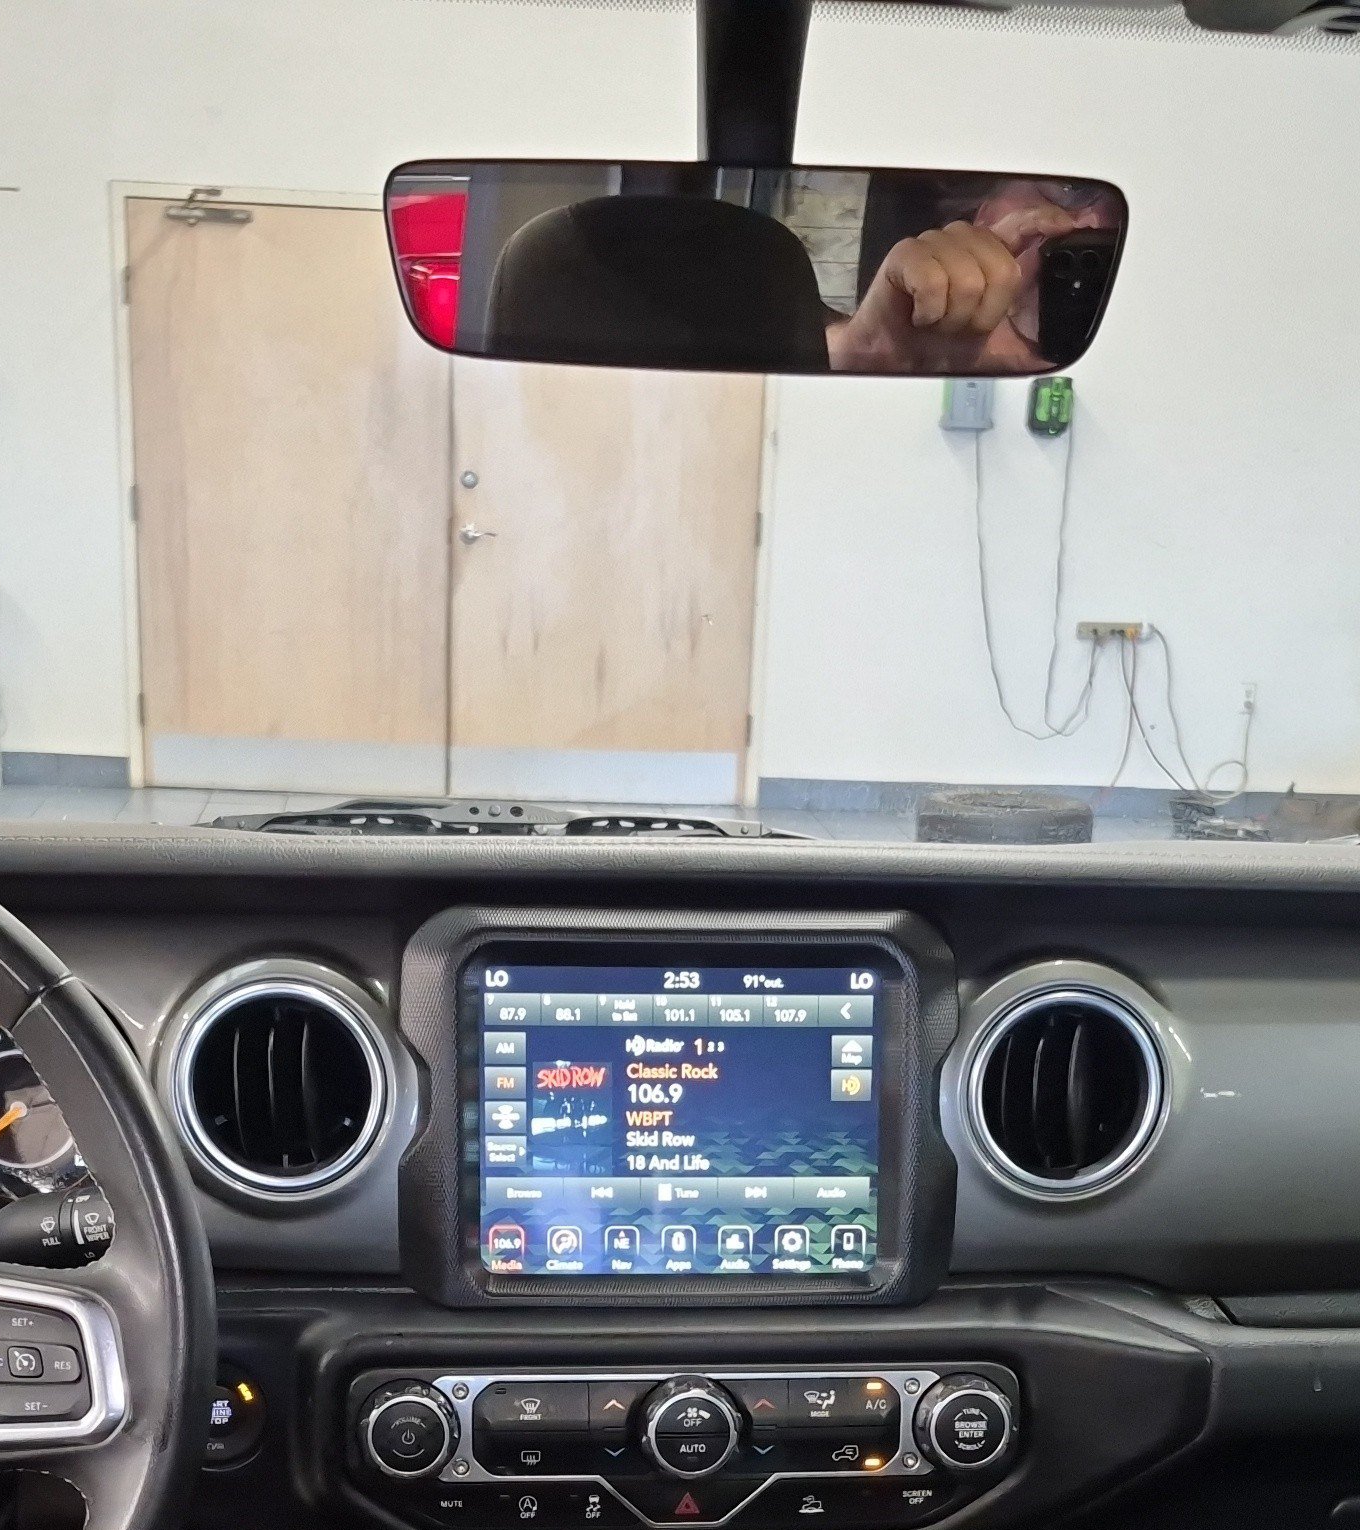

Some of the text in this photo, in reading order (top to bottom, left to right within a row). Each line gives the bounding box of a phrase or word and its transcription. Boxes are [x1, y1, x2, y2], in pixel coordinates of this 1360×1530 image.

[485, 970, 509, 987] LO
[663, 971, 700, 989] 2:53
[850, 972, 874, 990] LO
[664, 1009, 695, 1022] 101.1
[774, 1009, 807, 1022] 107.9
[537, 1066, 606, 1088] SKID ROW
[626, 1063, 719, 1079] Classic Rock
[497, 1077, 515, 1089] FM
[627, 1083, 683, 1104] 106.9
[626, 1111, 673, 1127] WBPT
[627, 1131, 696, 1147] Skid Row
[627, 1154, 710, 1171] 18 And Life
[54, 1360, 71, 1371] RES
[865, 1399, 888, 1411] A/C
[683, 1418, 702, 1428] OFF
[954, 1420, 988, 1430] BROWSE
[958, 1430, 984, 1439] ENTER
[679, 1443, 706, 1453] AUTO
[902, 1490, 932, 1498] SCREEN
[440, 1500, 463, 1508] MUTE
[520, 1511, 536, 1520] OFF
[586, 1511, 602, 1520] OFF
